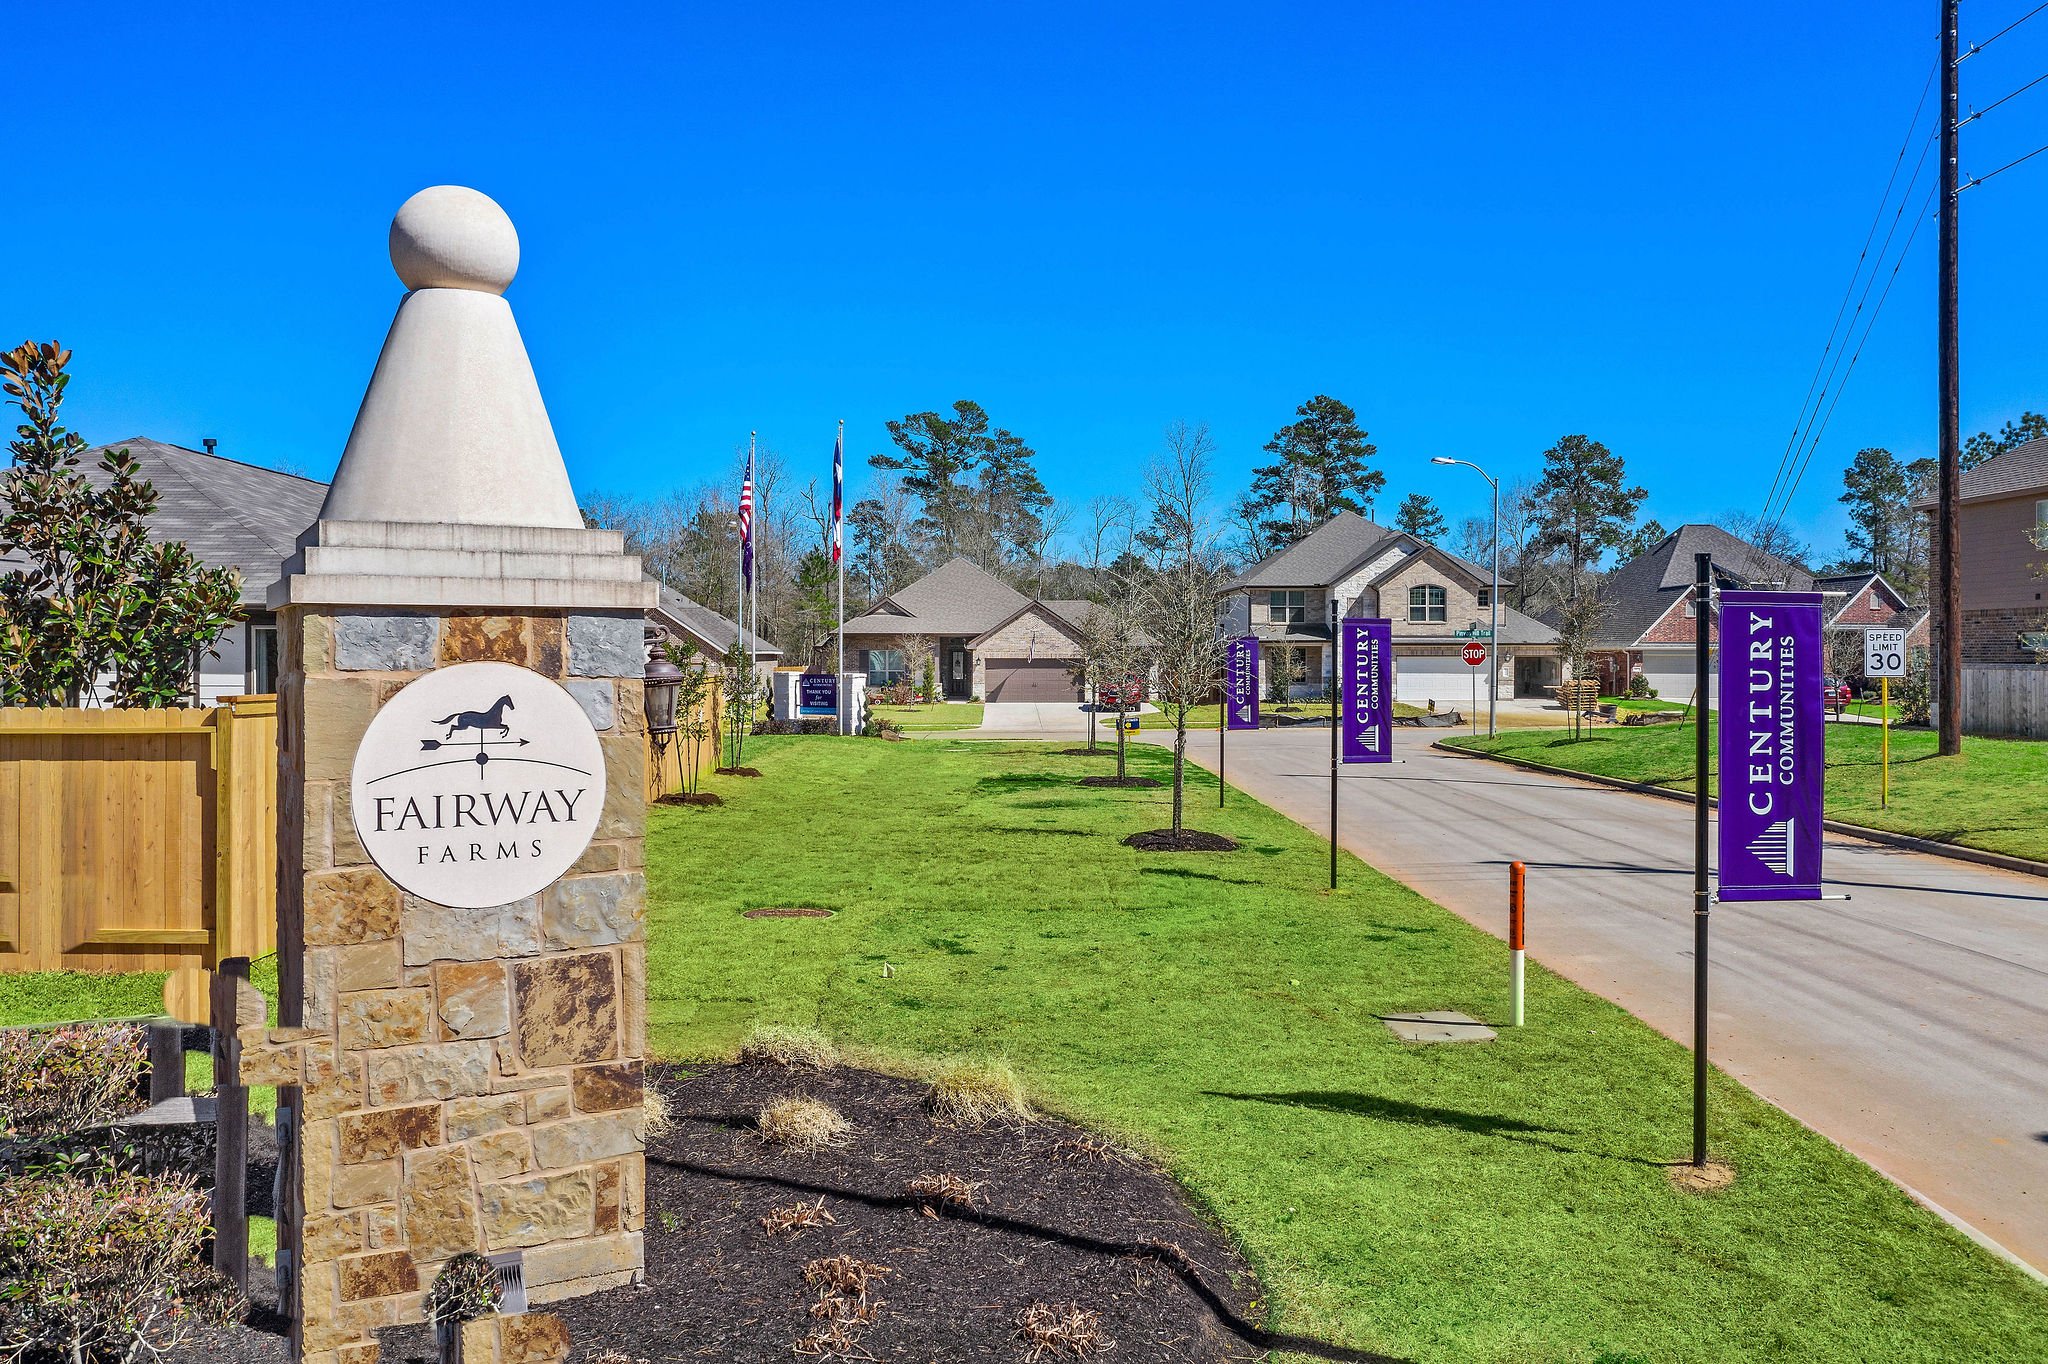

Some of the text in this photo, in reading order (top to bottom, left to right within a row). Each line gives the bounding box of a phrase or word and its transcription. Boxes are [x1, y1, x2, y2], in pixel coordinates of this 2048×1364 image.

[1463, 649, 1485, 659] STOP
[1869, 633, 1902, 641] SPEED
[1872, 643, 1898, 651] LIMIT
[1236, 642, 1245, 705] CENTURY
[1356, 627, 1369, 724] CENTURY
[1371, 638, 1379, 710] COMMUNITIES
[1870, 653, 1901, 670] 30
[1748, 611, 1774, 816] CENTURY
[1779, 635, 1795, 786] COMMUNITIES
[373, 788, 586, 832] FAIRWAY
[417, 839, 542, 865] FARMS
